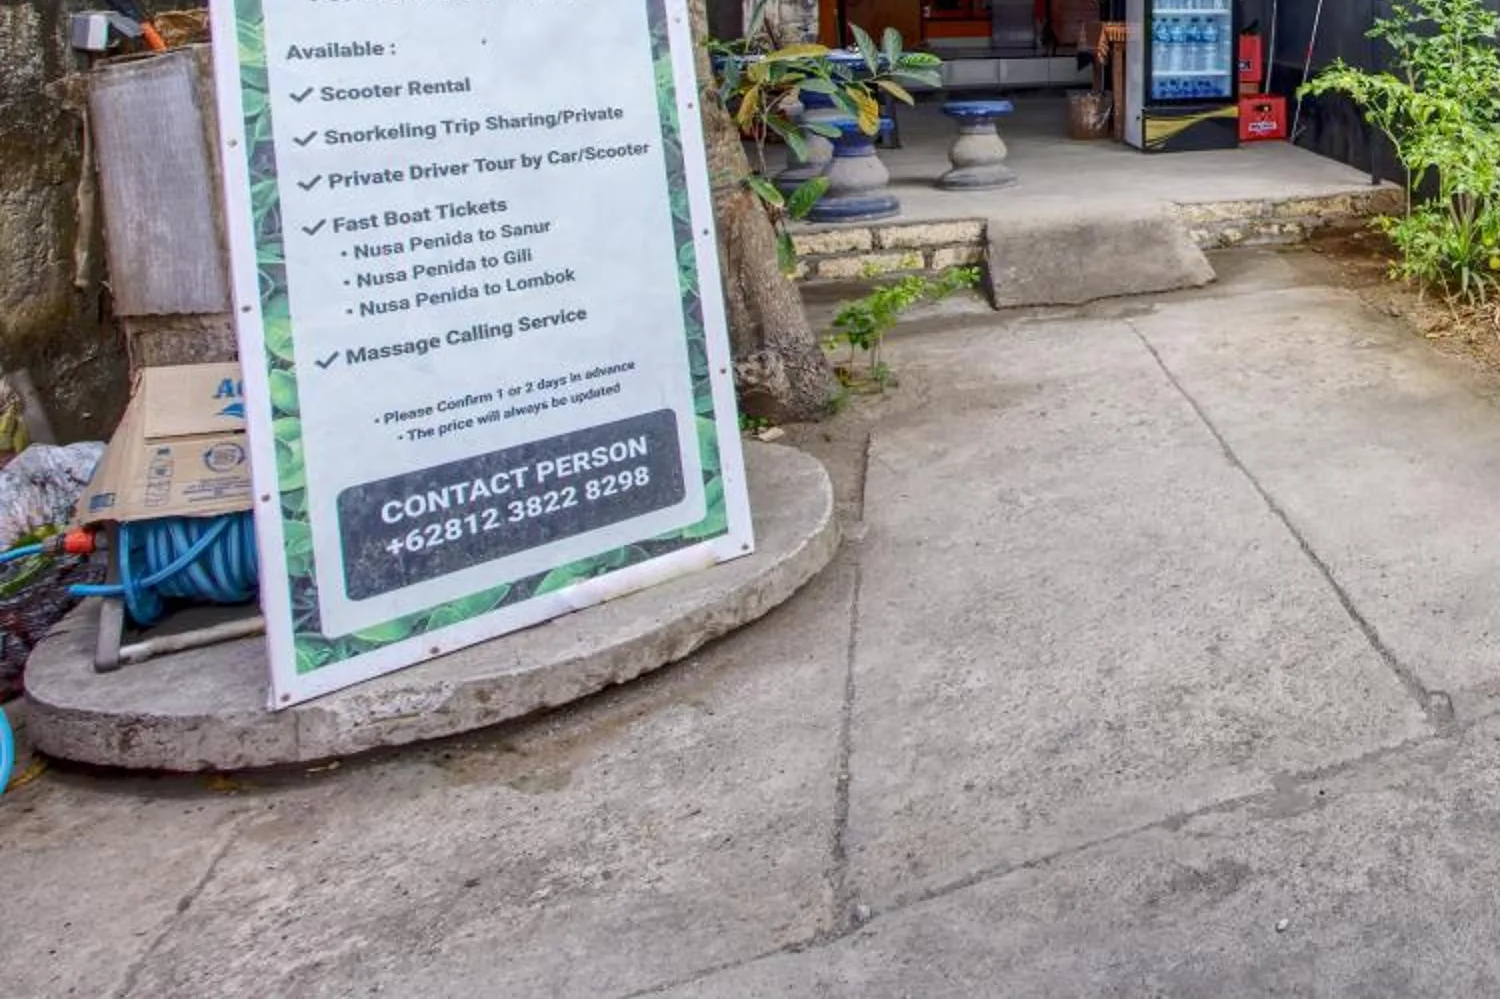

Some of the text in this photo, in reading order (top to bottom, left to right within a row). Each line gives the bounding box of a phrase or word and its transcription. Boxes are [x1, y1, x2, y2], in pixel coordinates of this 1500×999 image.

[285, 40, 384, 59] Available
[319, 76, 471, 101] Scooter Rental
[323, 106, 623, 145] Snorkeling Trip Sharing/Private
[327, 143, 649, 189] Private Driver Tour by Car/Scooter
[332, 199, 508, 233] Fast Boat Tickets
[353, 221, 550, 259] Nusa Penida to Sanur
[356, 247, 532, 288] Nusa Penida to Gili
[359, 267, 576, 317] Nusa Penida to Lombok
[345, 308, 587, 365] Massage Calling Service
[383, 360, 635, 424] Please Confirm 1 or 2 days in advance
[406, 381, 620, 441] The price will always be updated
[381, 435, 647, 523] CONTACT PERSON
[385, 465, 649, 555] +62812 3822 8298
